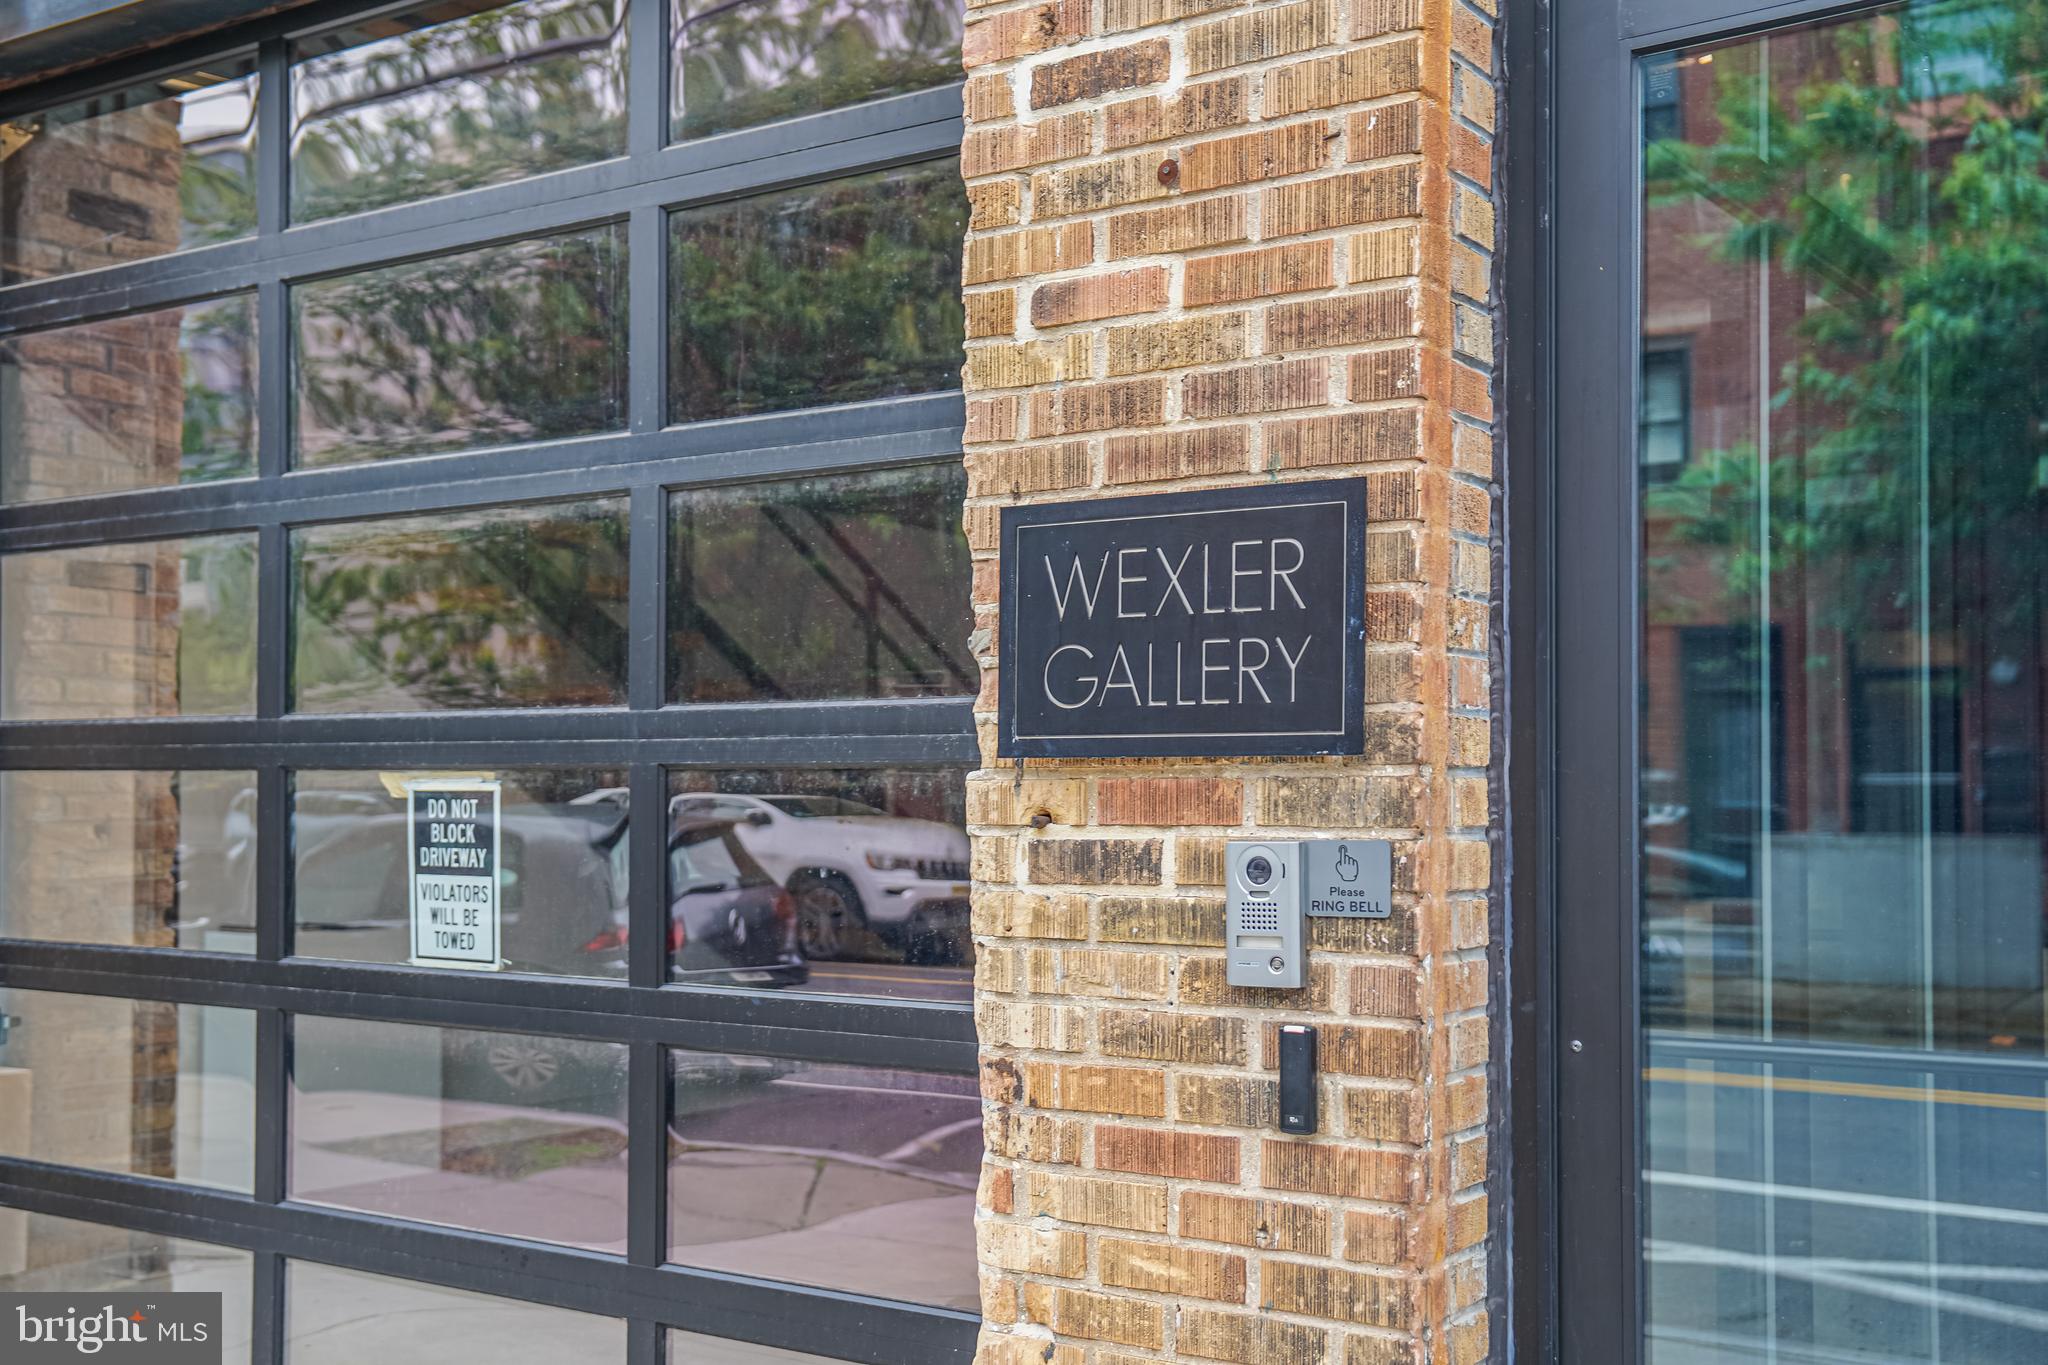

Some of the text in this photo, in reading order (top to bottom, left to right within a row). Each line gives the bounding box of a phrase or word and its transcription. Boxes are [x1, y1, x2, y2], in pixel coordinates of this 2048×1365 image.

[1045, 538, 1306, 621] WEXLER
[1044, 635, 1312, 709] GALLERY
[428, 799, 479, 819] DO NOT
[430, 823, 476, 844] BLOCK
[420, 847, 488, 869] DRIVEWAY
[421, 883, 489, 904] VIOLATORS
[1329, 886, 1365, 897] Please
[1311, 900, 1383, 913] RING BELL
[430, 907, 480, 927] WILL BE
[434, 931, 475, 950] TOWED
